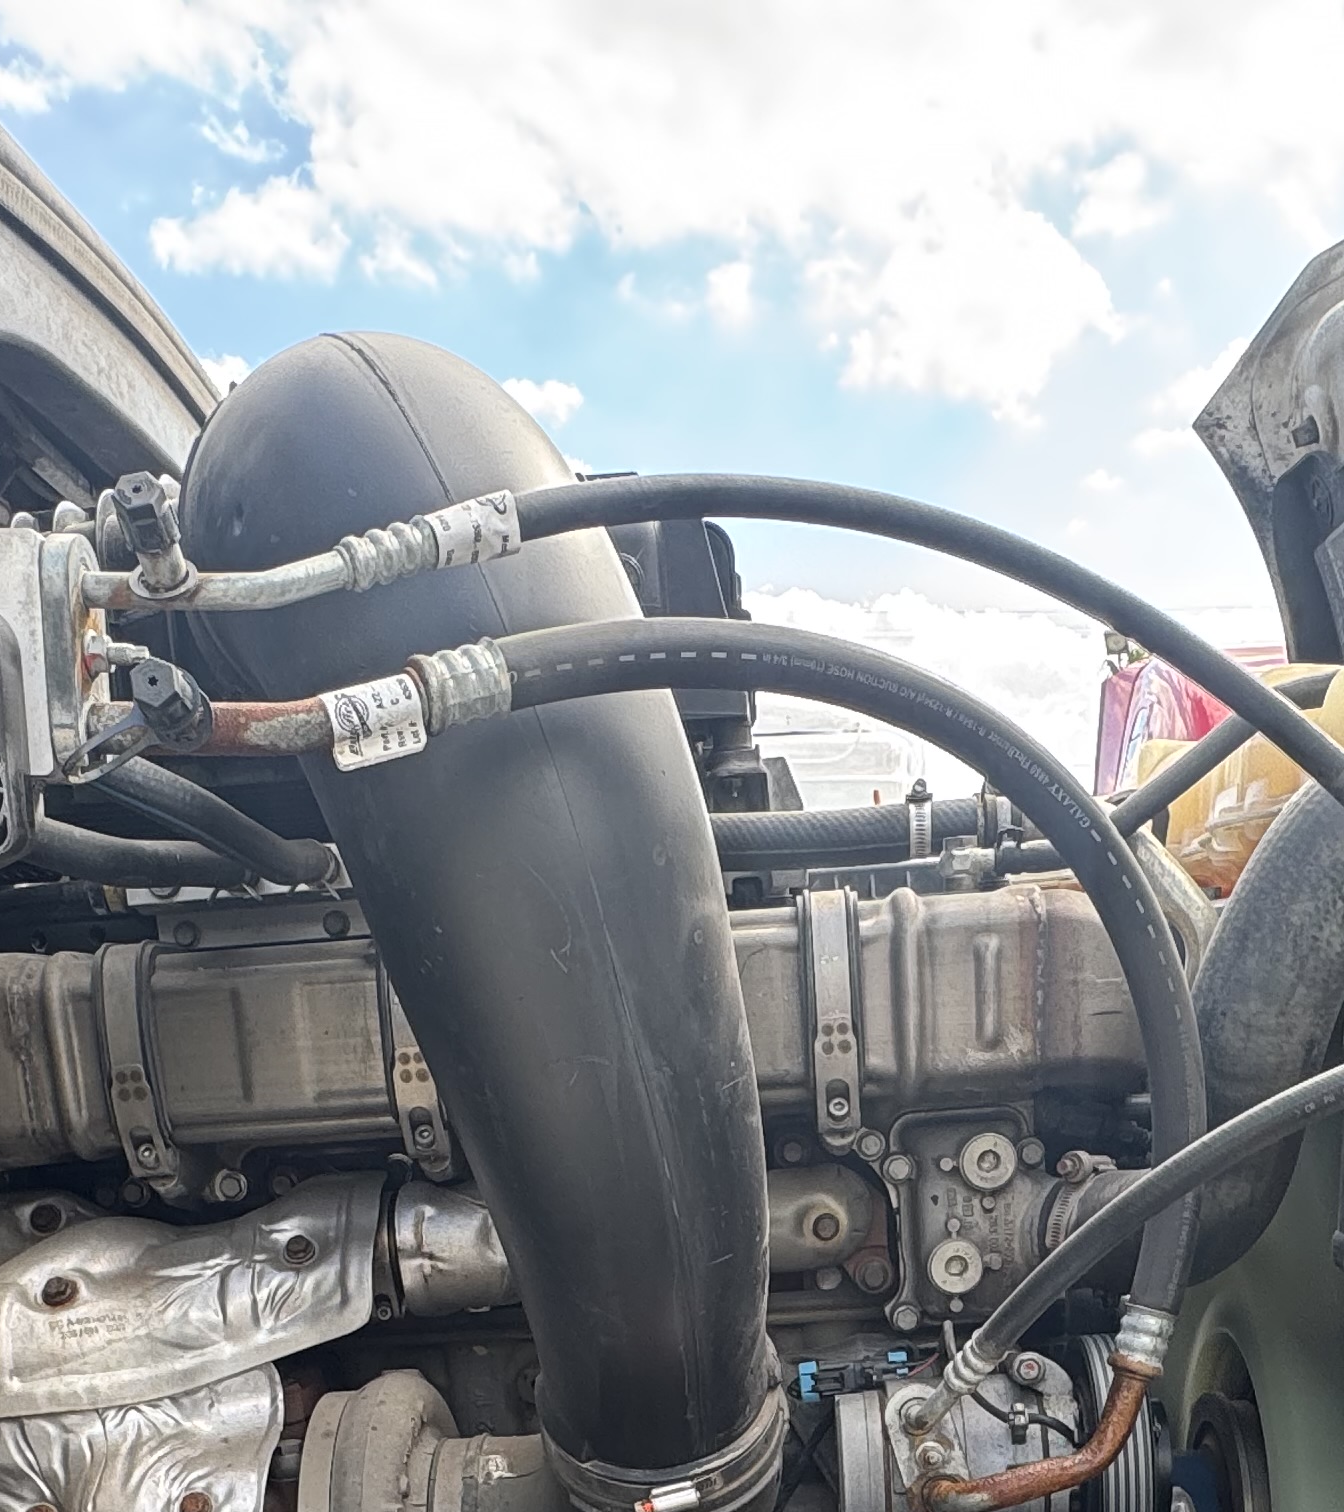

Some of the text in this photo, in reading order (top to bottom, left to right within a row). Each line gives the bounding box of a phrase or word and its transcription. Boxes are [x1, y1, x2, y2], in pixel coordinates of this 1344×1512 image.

[826, 664, 854, 678] HOSE
[856, 671, 898, 693] SUCTION
[899, 685, 916, 700] A/C
[1047, 784, 1090, 828] GALAXY
